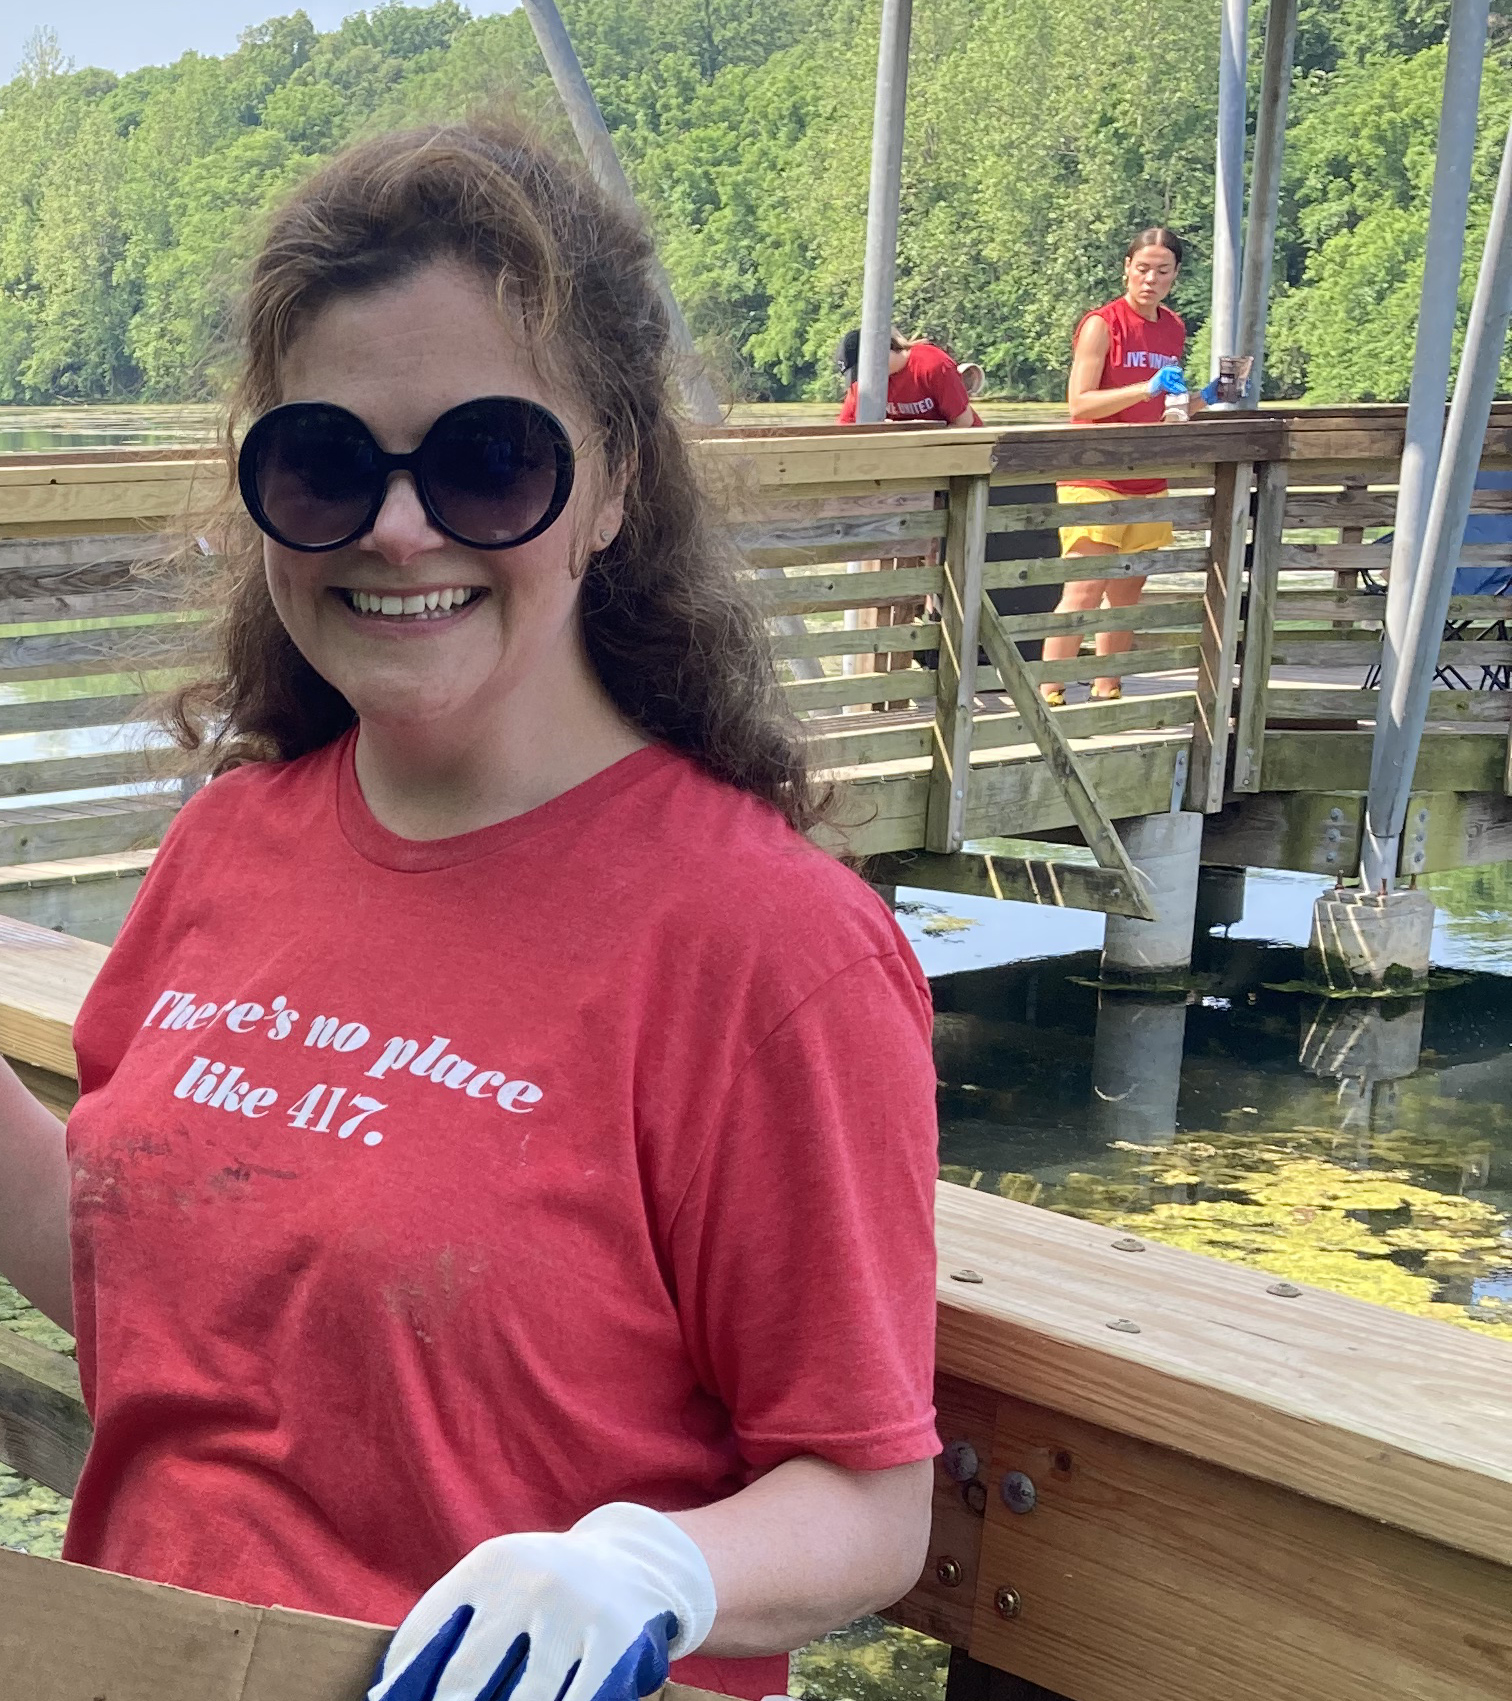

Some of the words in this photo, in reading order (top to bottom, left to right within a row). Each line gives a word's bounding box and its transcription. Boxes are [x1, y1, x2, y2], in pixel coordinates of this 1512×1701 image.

[897, 397, 934, 415] UNITED
[142, 989, 299, 1040] There's
[303, 1014, 370, 1052] no
[364, 1035, 543, 1114] place
[173, 1056, 278, 1118] like
[286, 1083, 389, 1146] 417.
